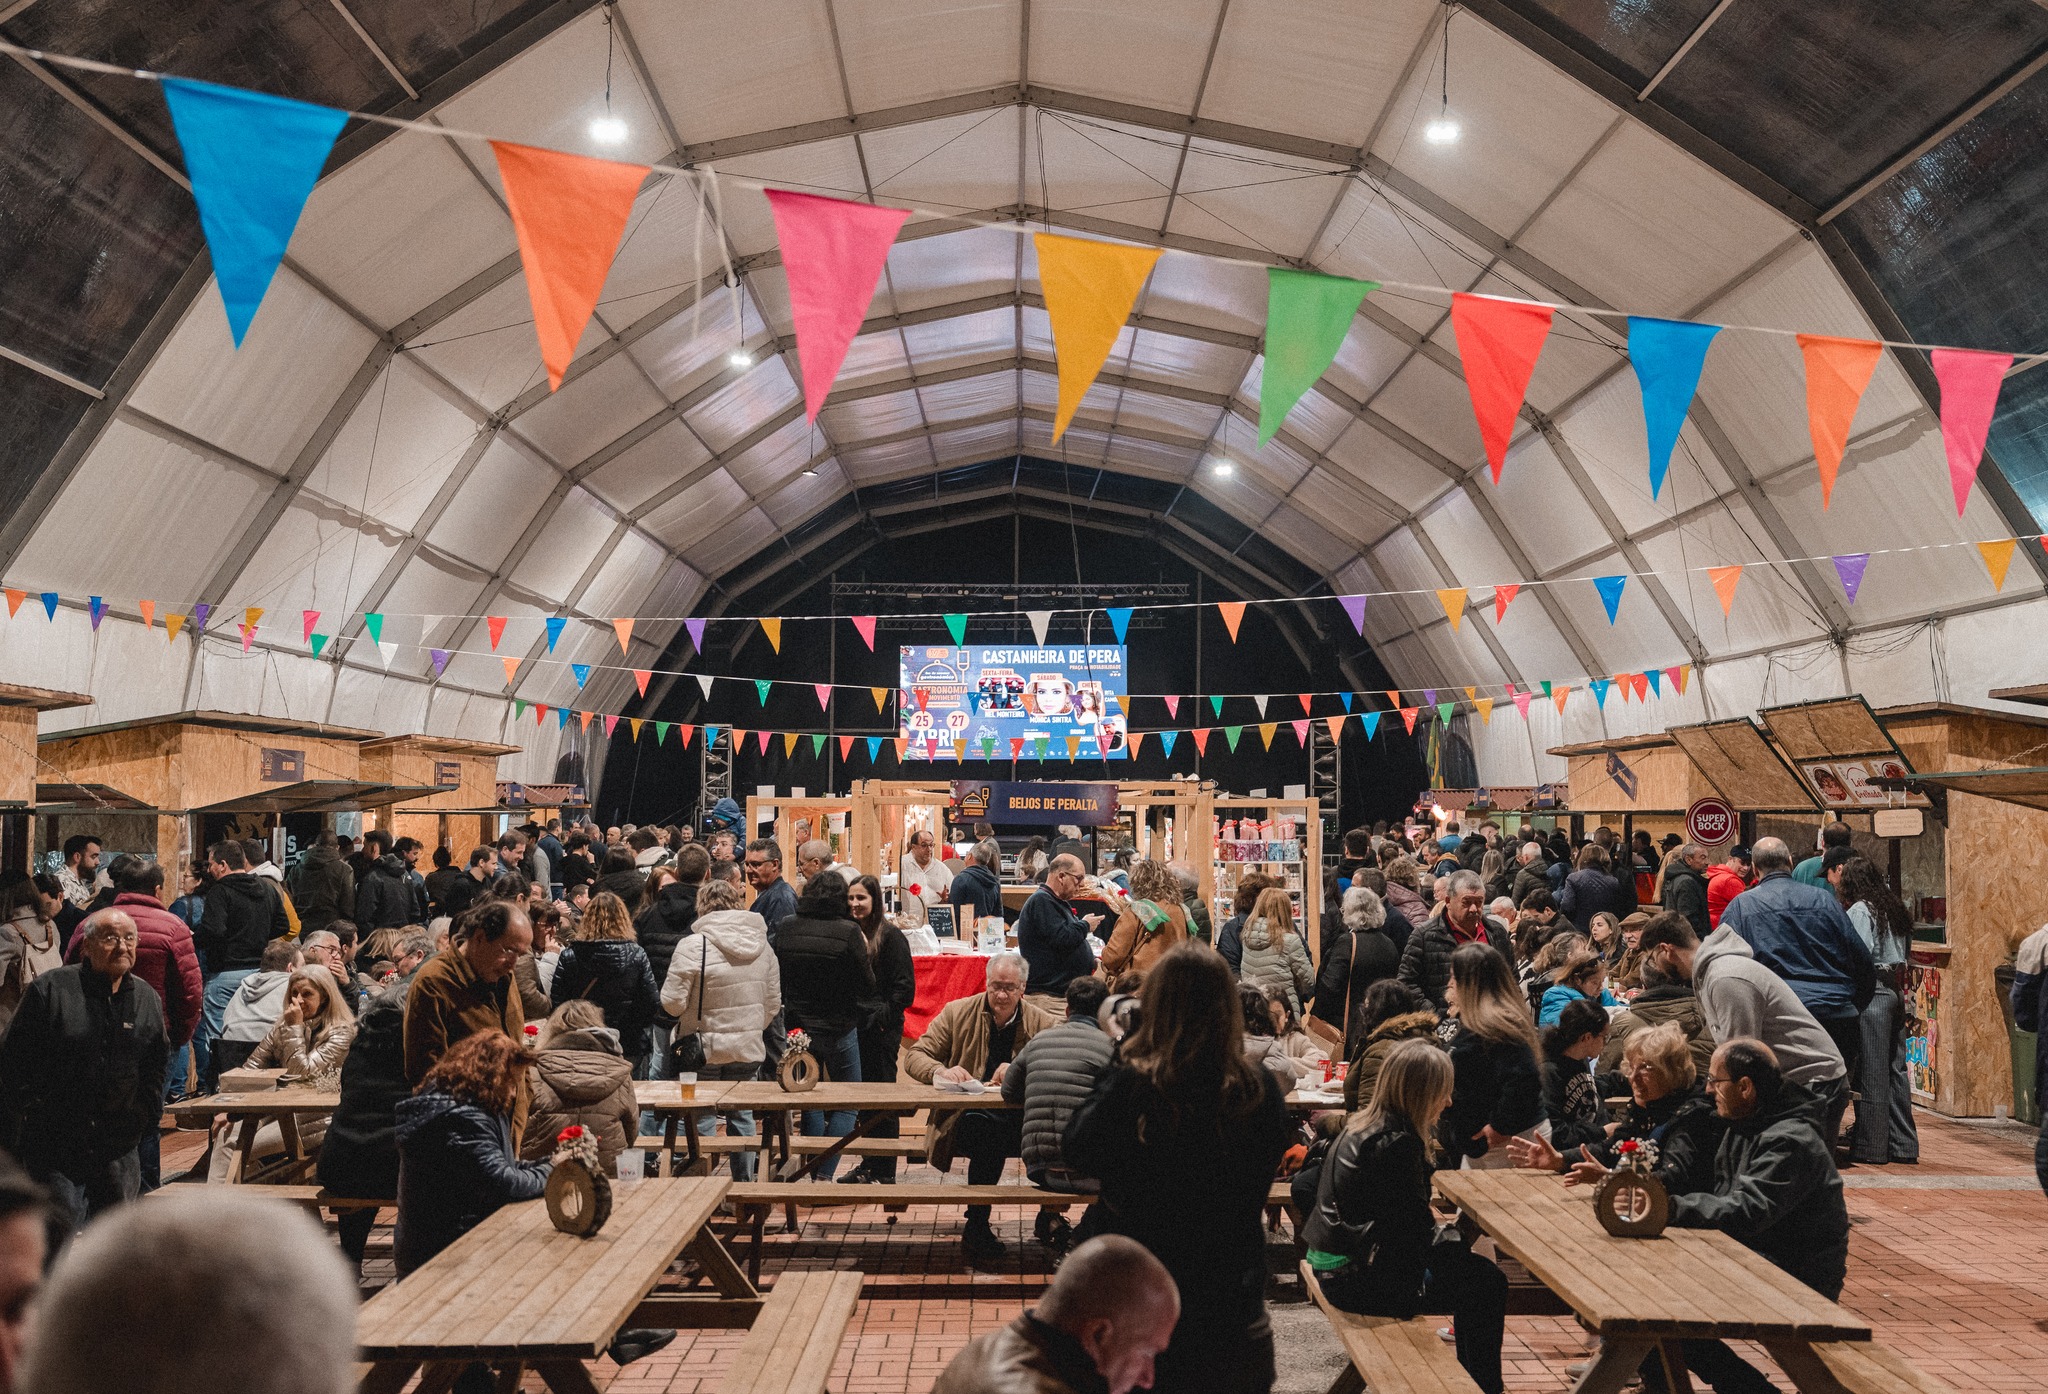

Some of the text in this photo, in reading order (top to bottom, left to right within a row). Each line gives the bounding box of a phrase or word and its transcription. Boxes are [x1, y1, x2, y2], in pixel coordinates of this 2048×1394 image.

[982, 650, 1121, 664] CASTANHEIRA DE PERA
[916, 715, 929, 727] 25
[952, 715, 964, 727] 27
[1009, 797, 1098, 811] BEIJOS DE PERALTA
[1696, 814, 1726, 823] SUPER
[1698, 822, 1725, 831] BOCK
